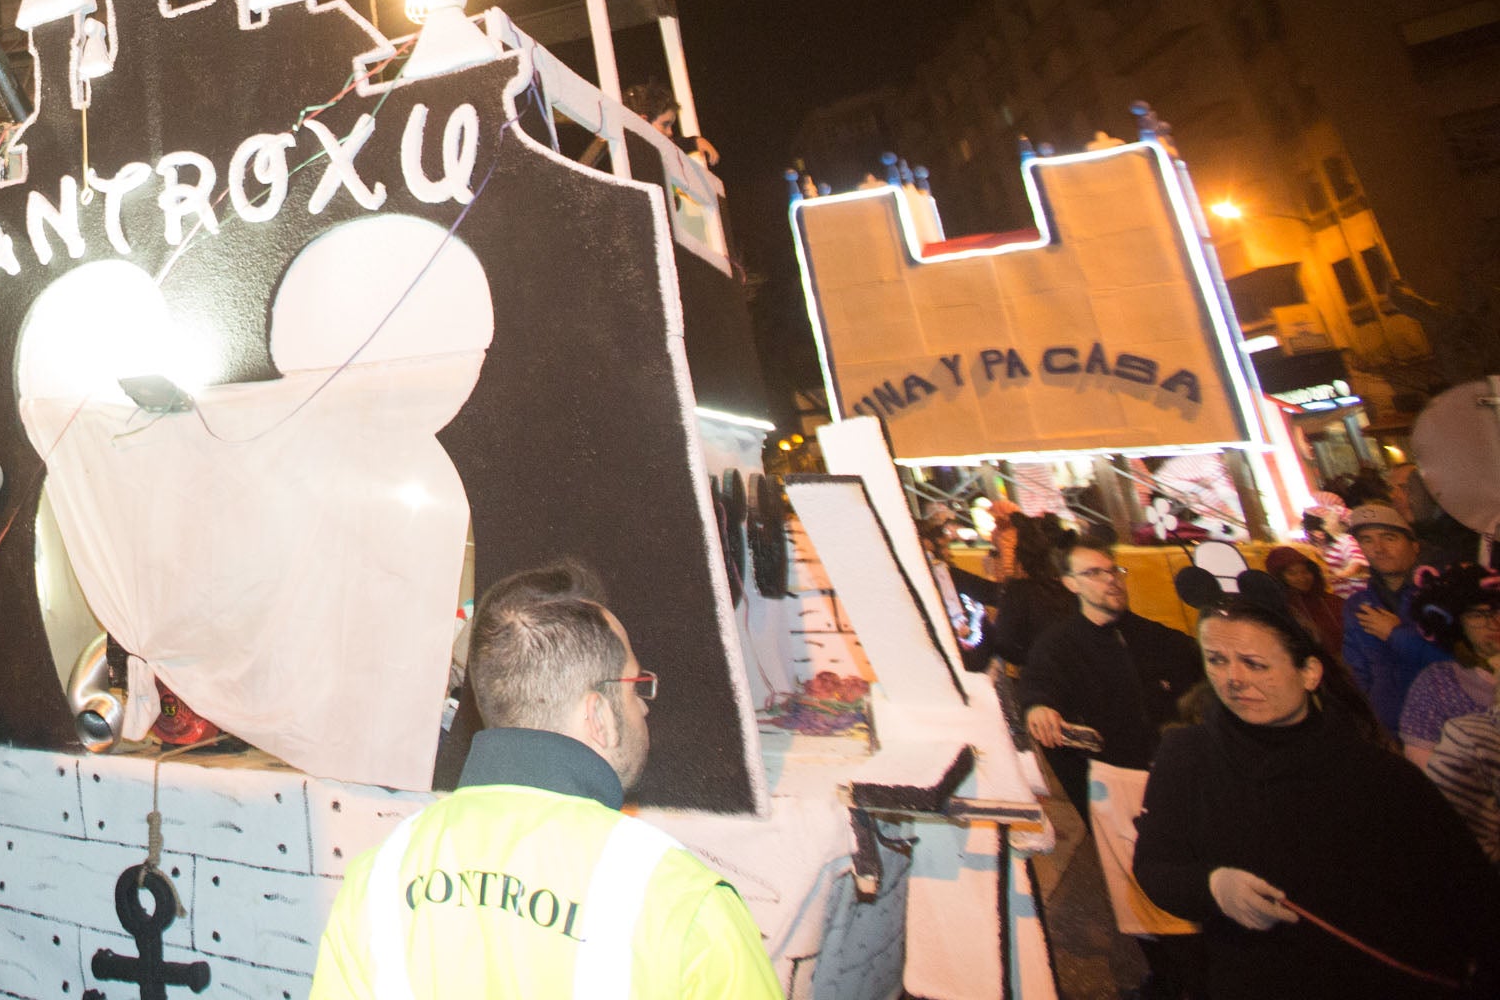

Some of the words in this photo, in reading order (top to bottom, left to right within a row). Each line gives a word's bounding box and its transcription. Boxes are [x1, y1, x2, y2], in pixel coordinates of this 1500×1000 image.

[940, 354, 964, 387] Y
[981, 348, 1030, 381] PA
[1042, 342, 1203, 404] CASA
[405, 868, 587, 943] CONTROL
